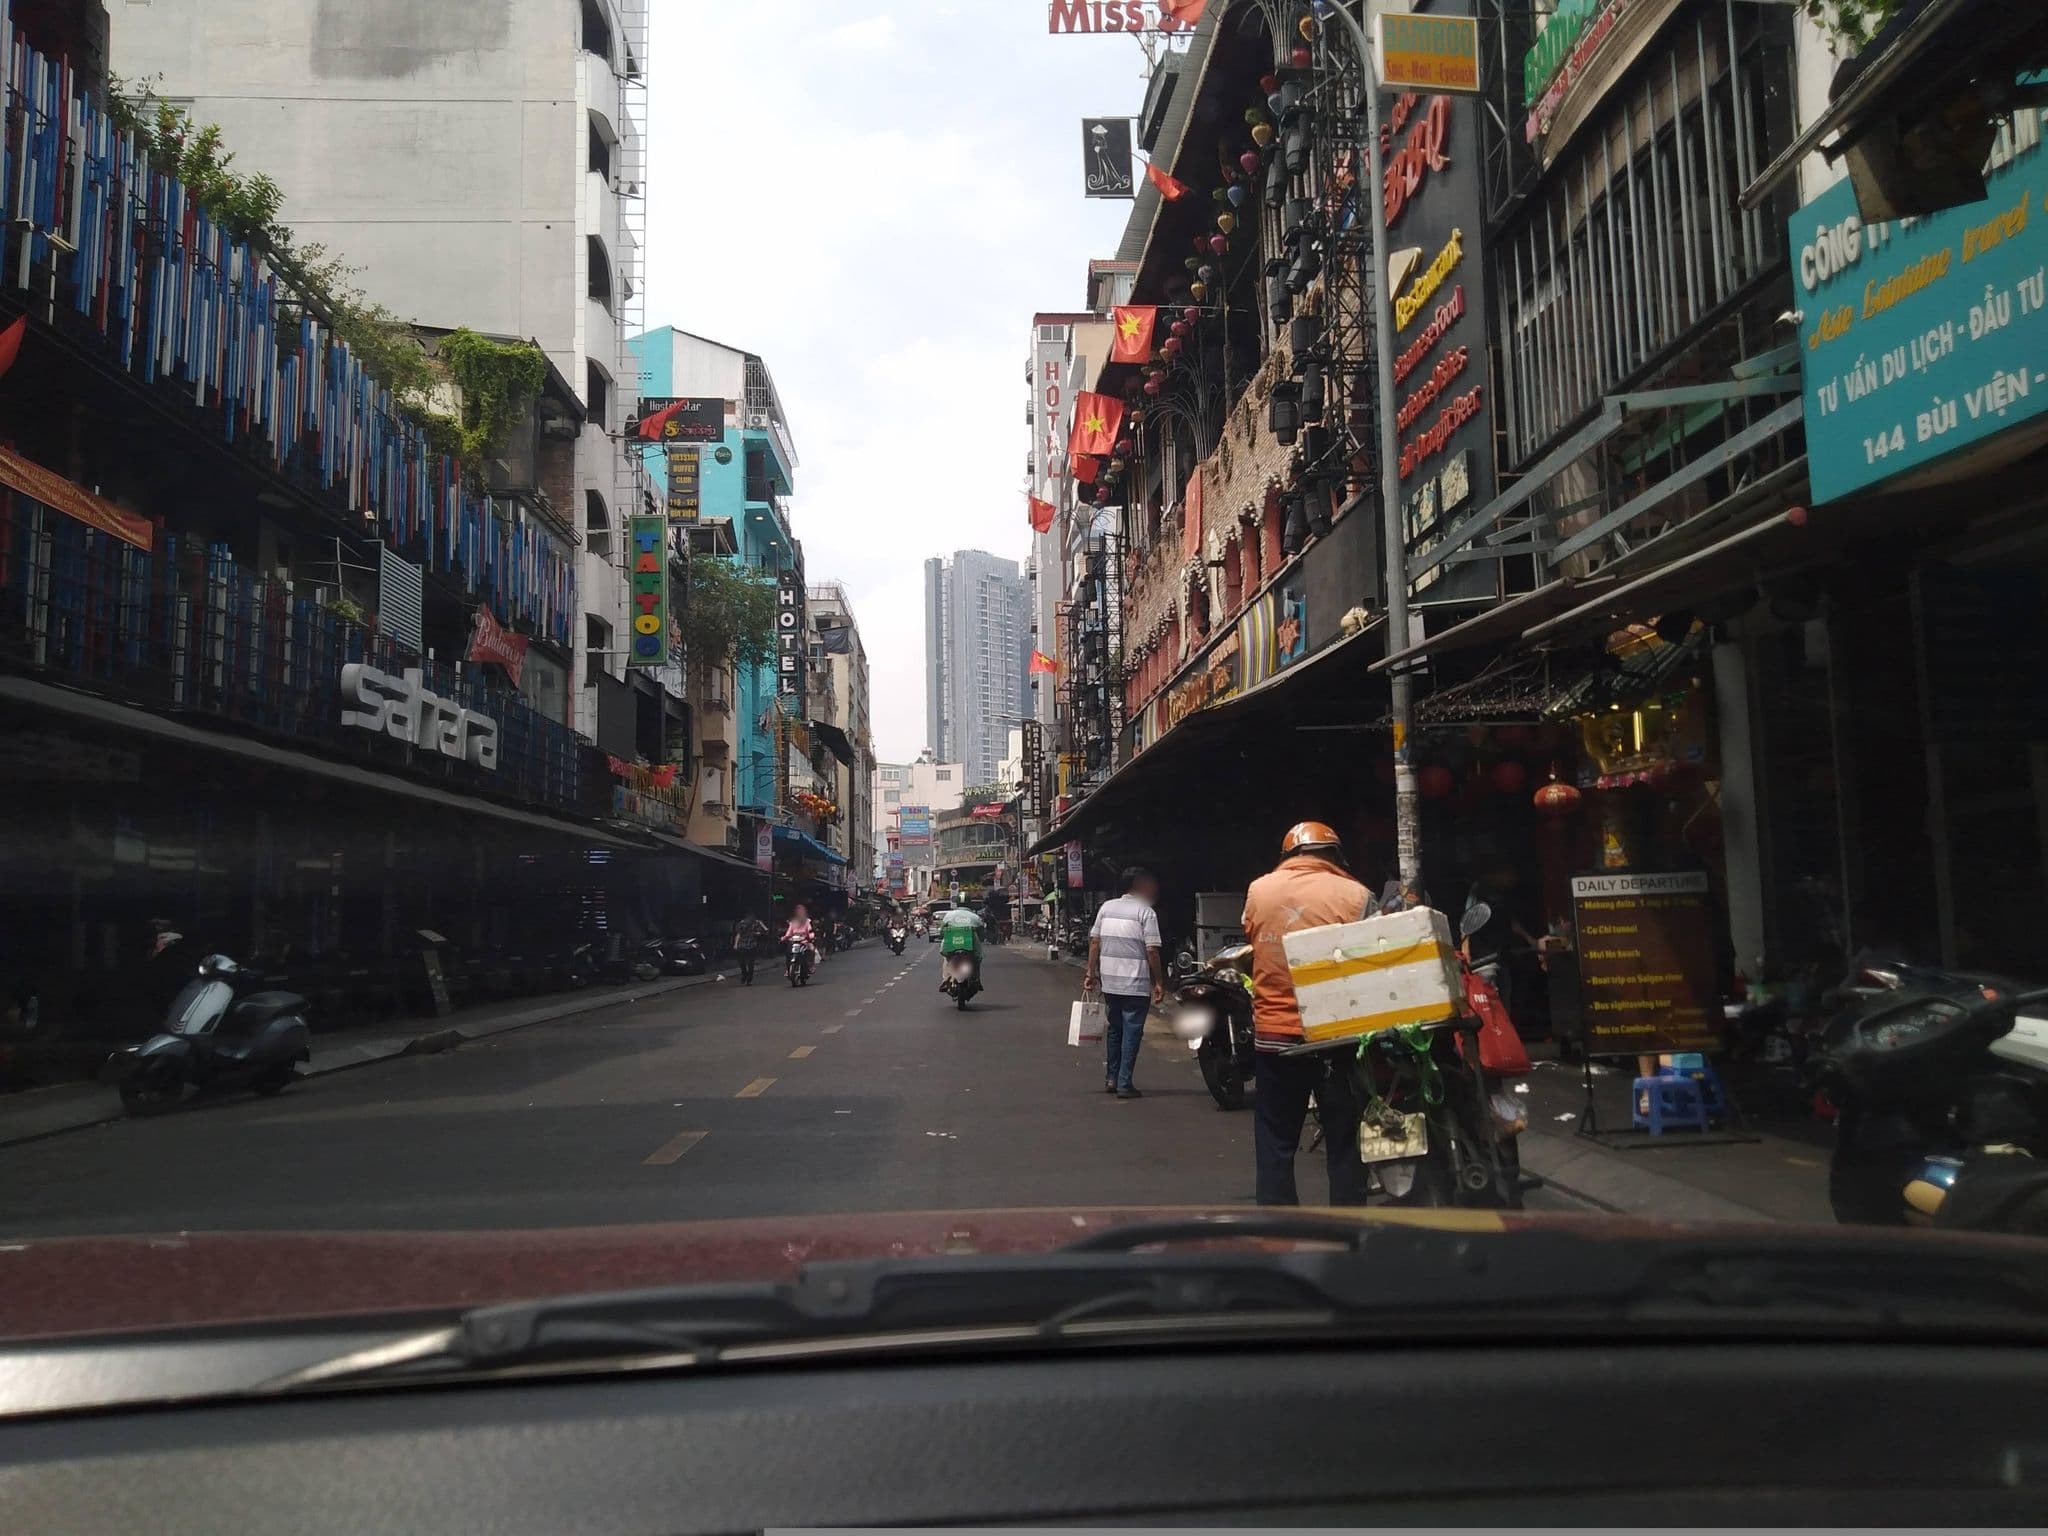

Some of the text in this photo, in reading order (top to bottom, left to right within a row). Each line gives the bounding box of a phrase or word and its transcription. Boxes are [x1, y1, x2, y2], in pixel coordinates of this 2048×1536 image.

[1383, 19, 1474, 58] BAMBOO
[1395, 227, 1464, 335] Restaurant
[1800, 215, 1863, 291] CÔNG
[1816, 376, 1838, 417] TƯ
[1843, 352, 1879, 403] VẤN
[1882, 345, 1907, 387] DU
[1910, 320, 1954, 375] LỊCH
[1968, 284, 2012, 341] ĐẦU
[2015, 264, 2046, 317] TƯ
[1862, 424, 1906, 465] 144
[1916, 395, 1958, 443] BÙI
[1962, 367, 2031, 421] VIỆN
[635, 530, 661, 657] TATTOO
[780, 589, 796, 694] HOTEL
[1577, 880, 1617, 892] DAILY
